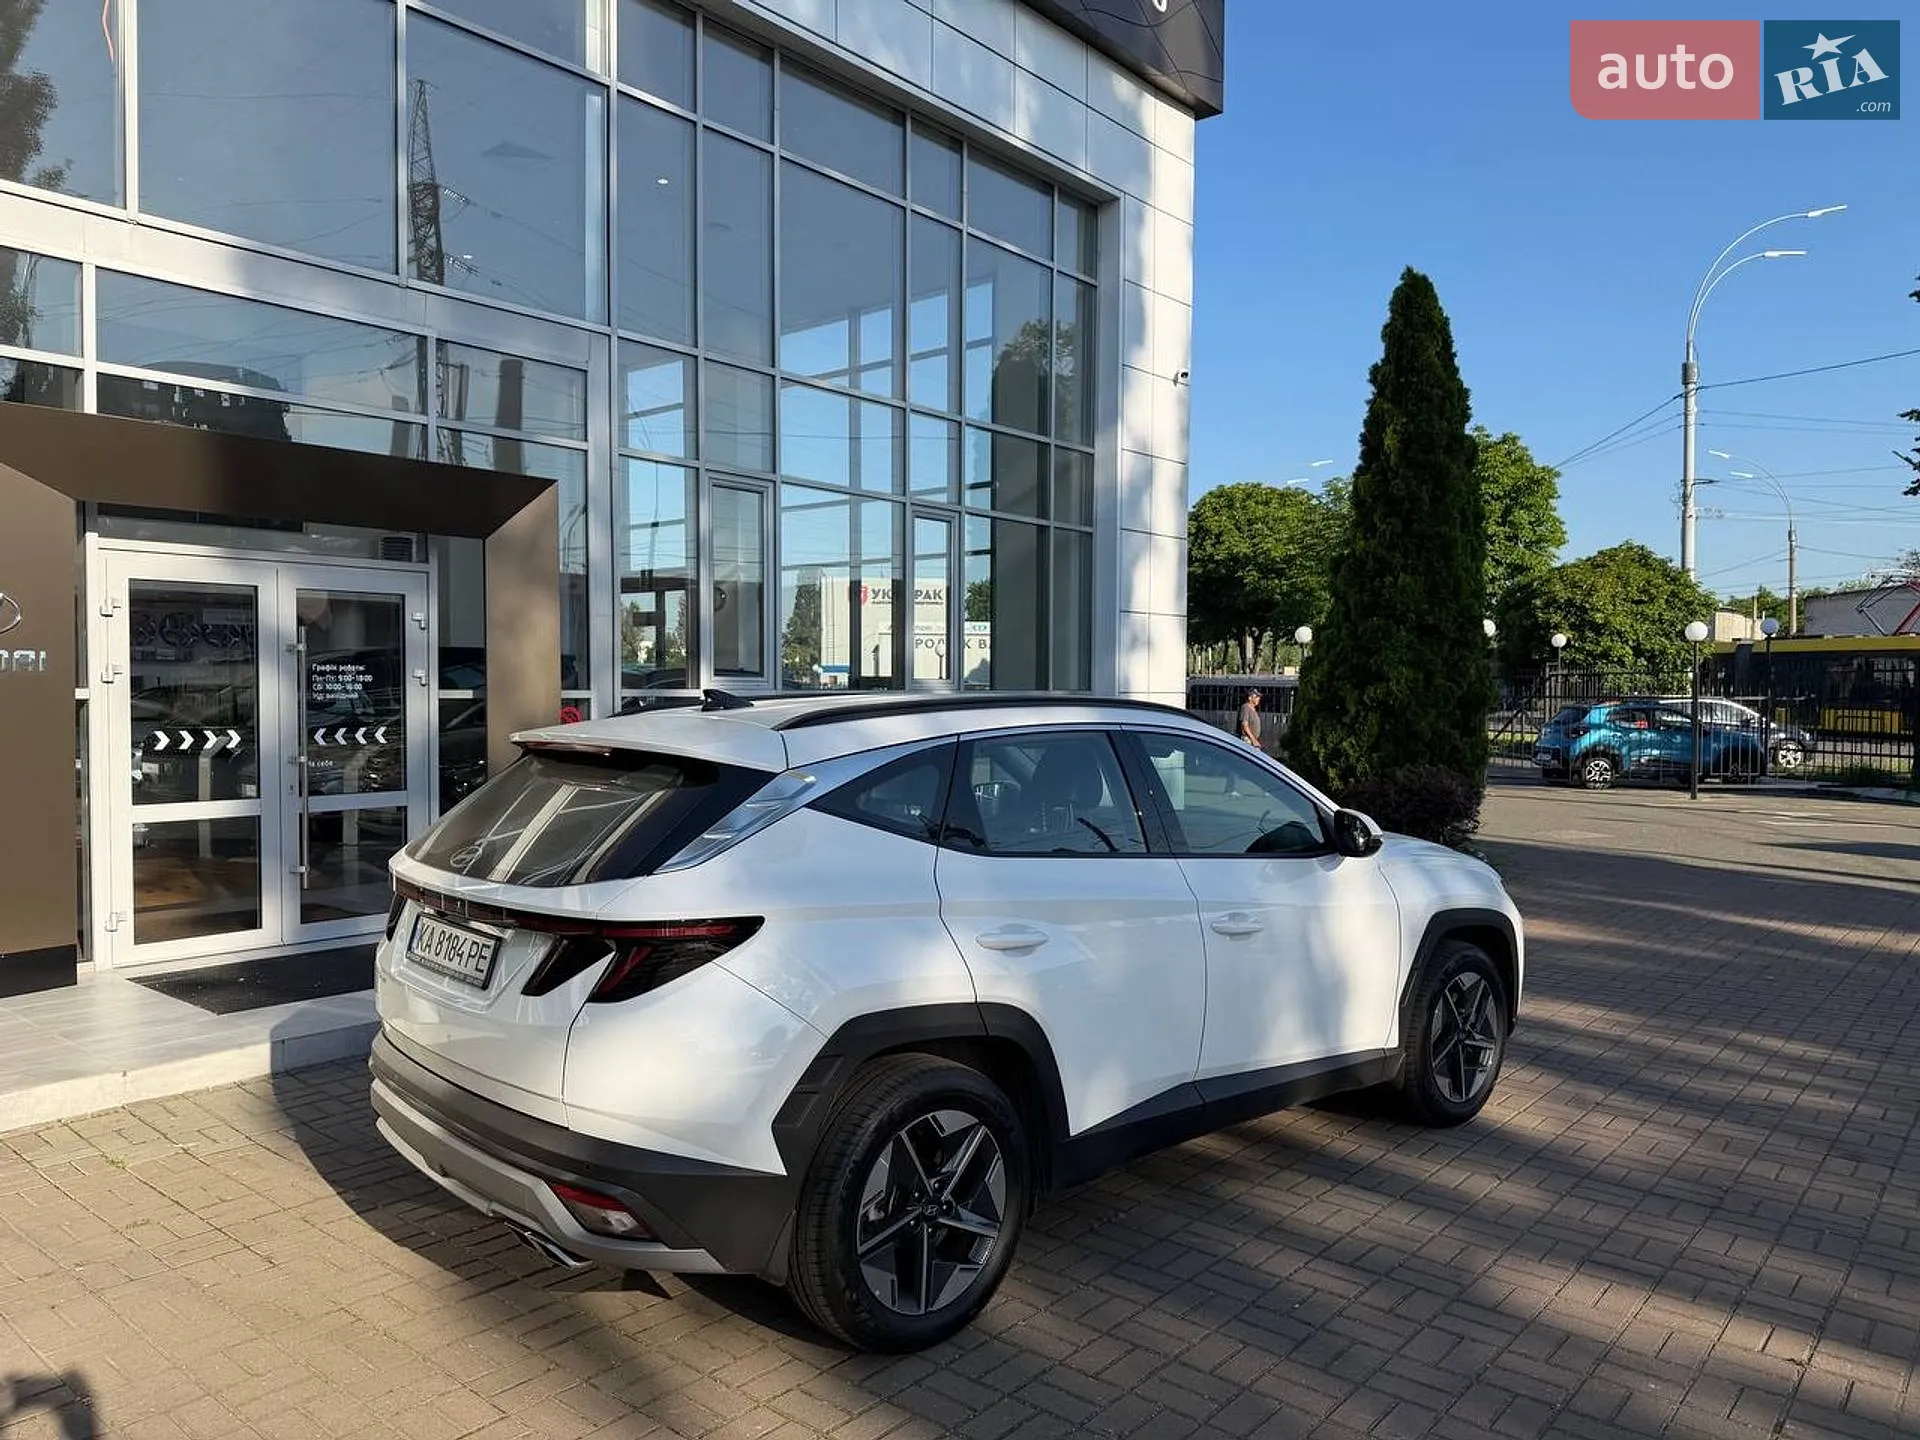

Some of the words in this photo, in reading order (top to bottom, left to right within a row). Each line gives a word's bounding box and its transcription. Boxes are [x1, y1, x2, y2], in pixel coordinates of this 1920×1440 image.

[417, 924, 435, 955] KA
[436, 930, 468, 966] 8184
[464, 941, 490, 973] PE
